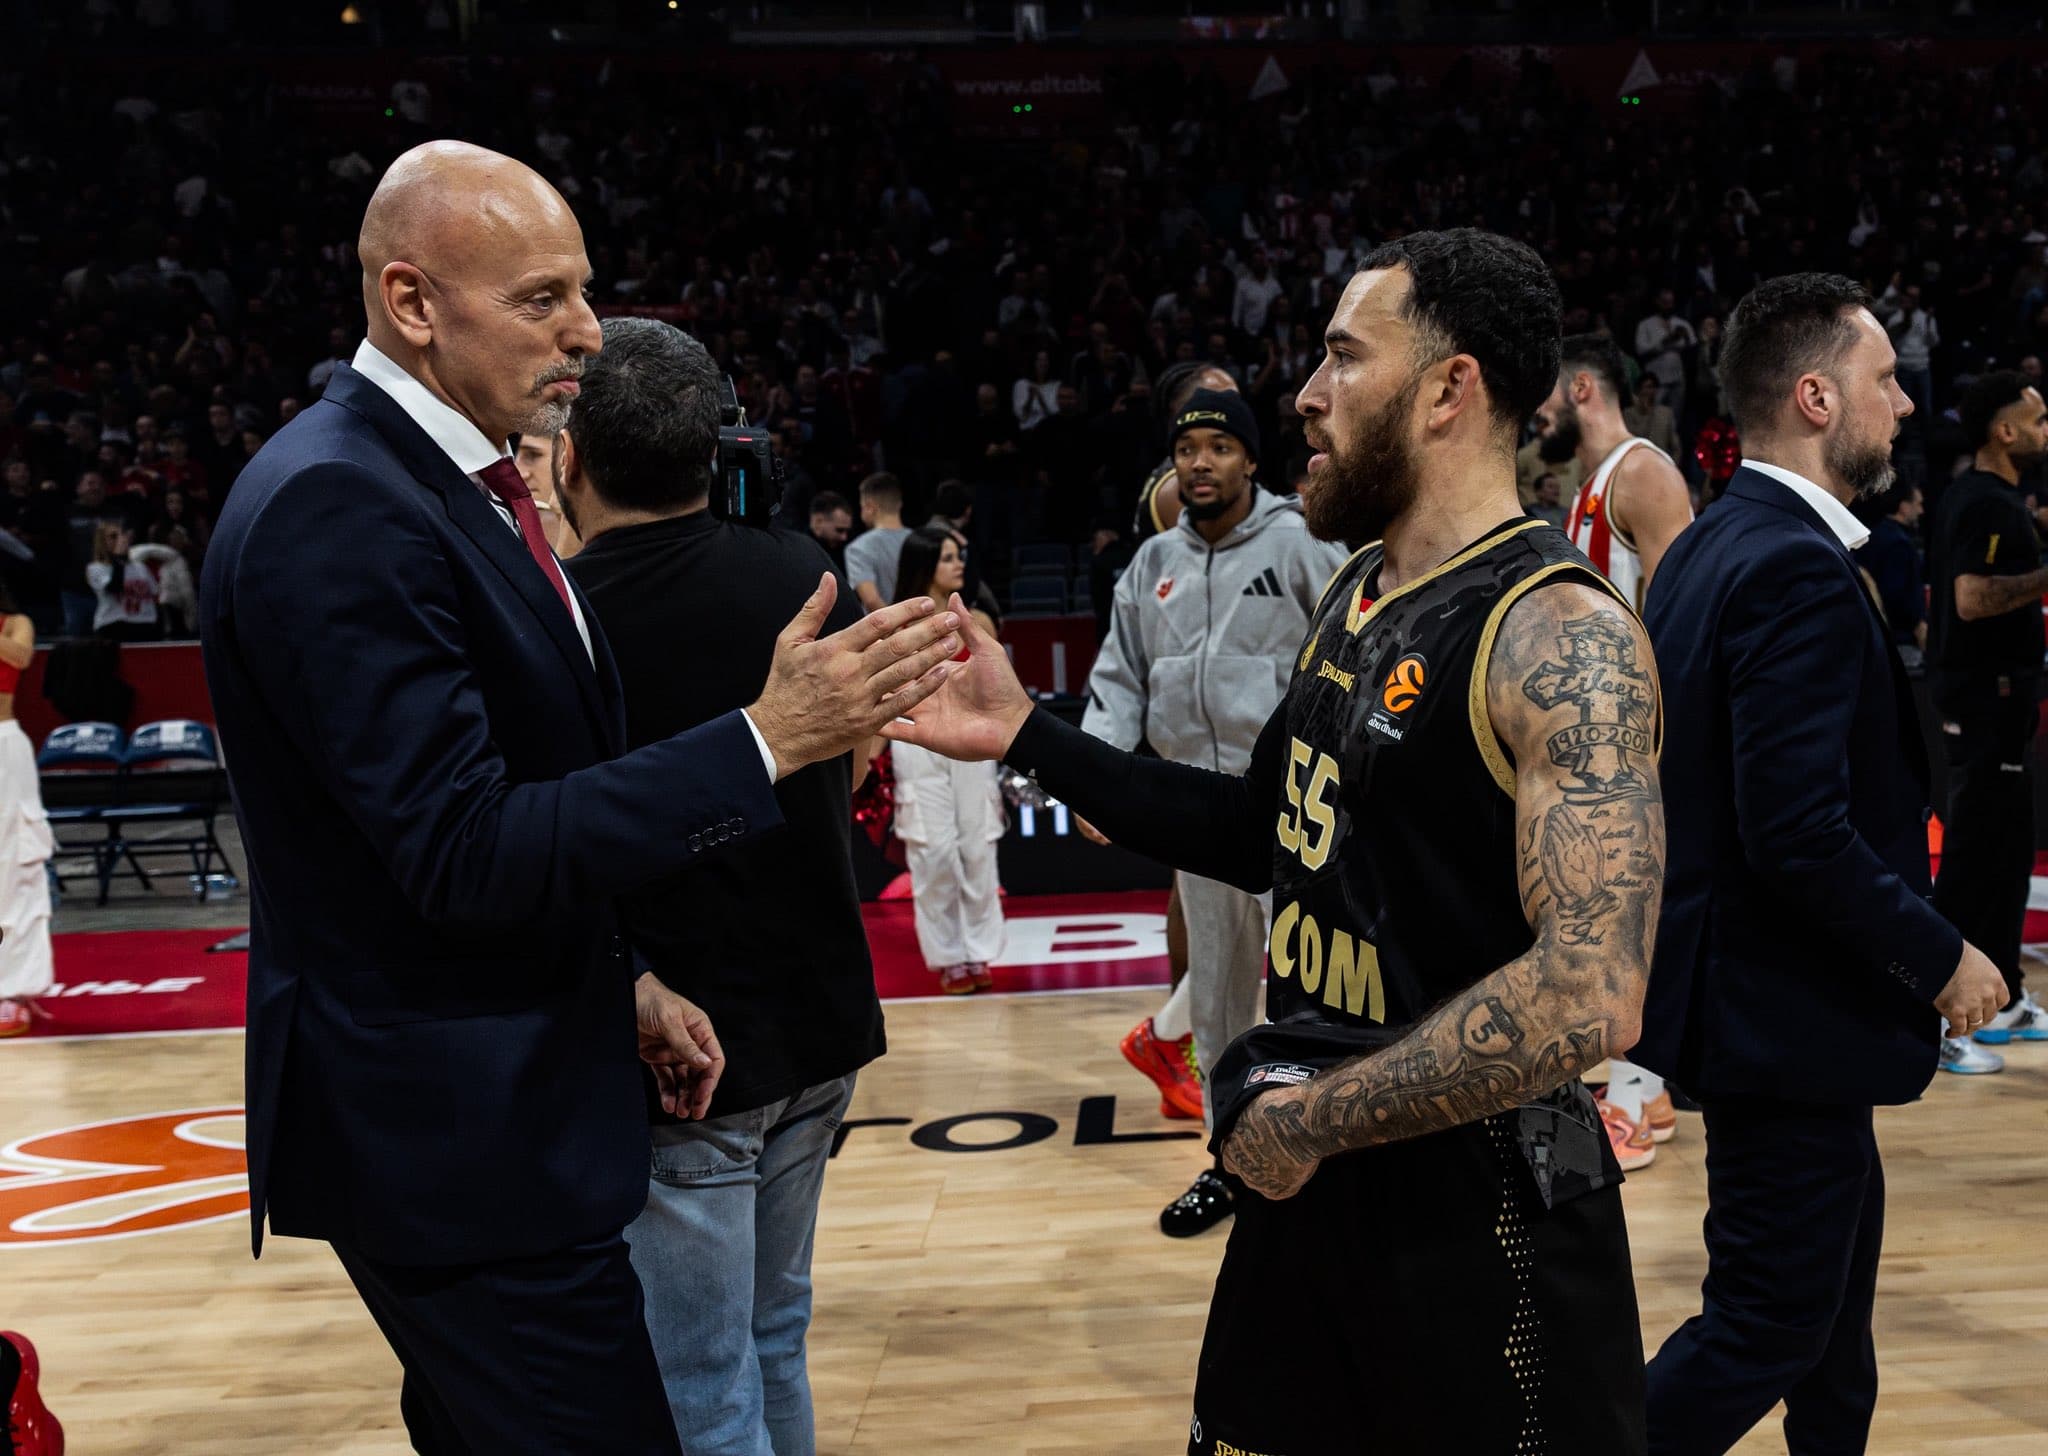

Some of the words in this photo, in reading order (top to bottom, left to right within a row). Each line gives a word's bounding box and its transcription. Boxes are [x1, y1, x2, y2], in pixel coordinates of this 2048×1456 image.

[1317, 659, 1356, 693] SPALDING
[1277, 736, 1341, 872] 55
[1269, 899, 1387, 1025] COM
